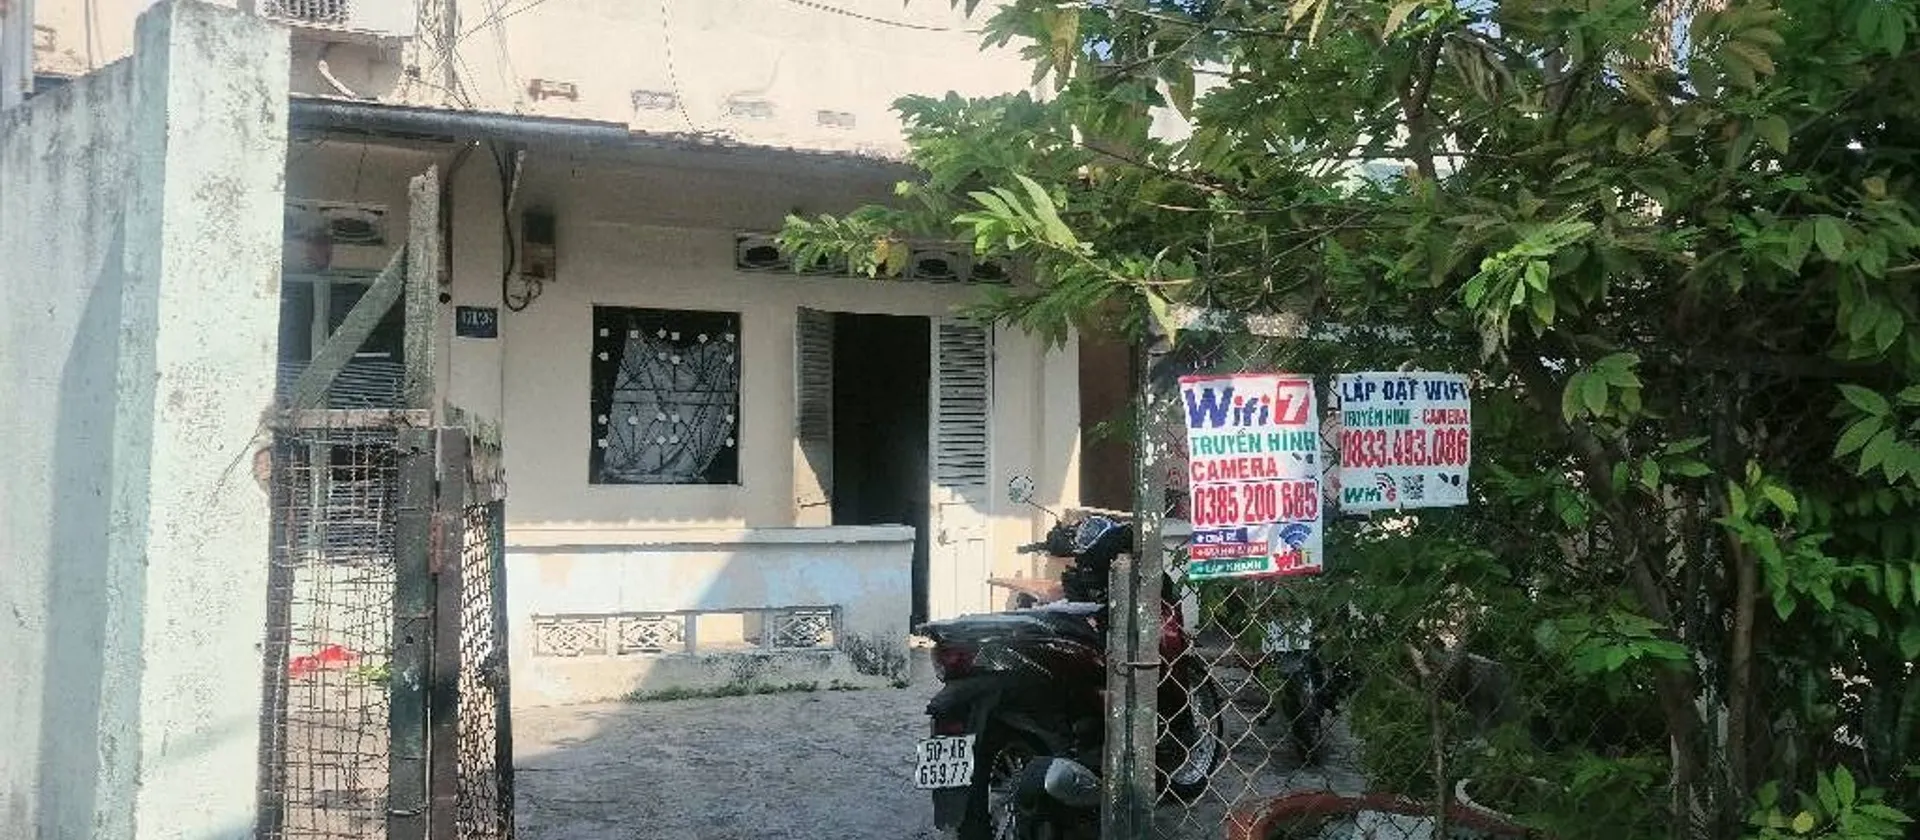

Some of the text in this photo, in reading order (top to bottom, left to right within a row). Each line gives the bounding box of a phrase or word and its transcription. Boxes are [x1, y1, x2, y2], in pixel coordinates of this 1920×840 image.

[1183, 383, 1308, 428] Wifi 7
[1422, 408, 1469, 425] CAMERA
[1190, 457, 1279, 482] CAMERA
[1194, 482, 1318, 526] 0385 200 685
[926, 739, 967, 762] 50-AB
[920, 761, 969, 785] 659.77
